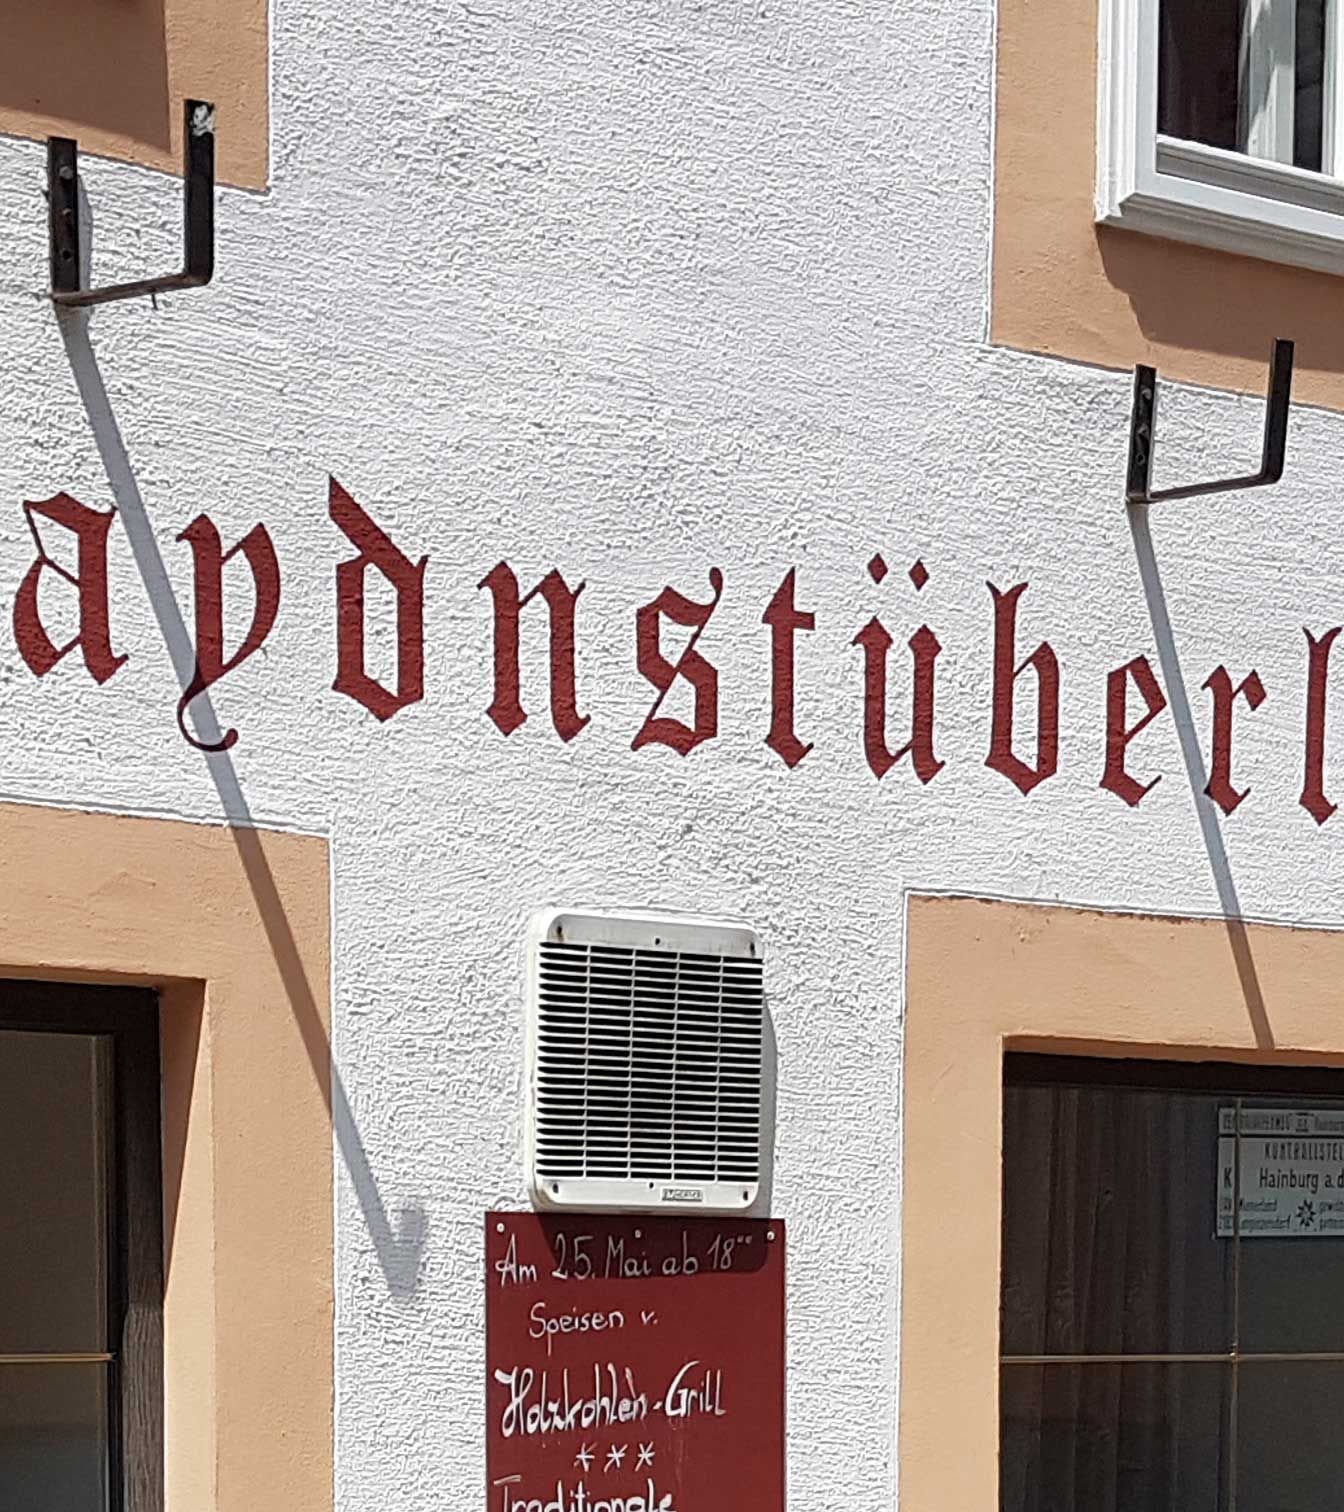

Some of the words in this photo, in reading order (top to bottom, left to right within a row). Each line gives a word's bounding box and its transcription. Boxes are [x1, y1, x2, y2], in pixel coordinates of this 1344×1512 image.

[1259, 1167, 1318, 1193] Hainburg
[495, 1233, 537, 1287] Am
[552, 1233, 596, 1281] 25.
[605, 1234, 651, 1280] Mai
[661, 1231, 698, 1275] ab
[529, 1302, 625, 1356] Speisen
